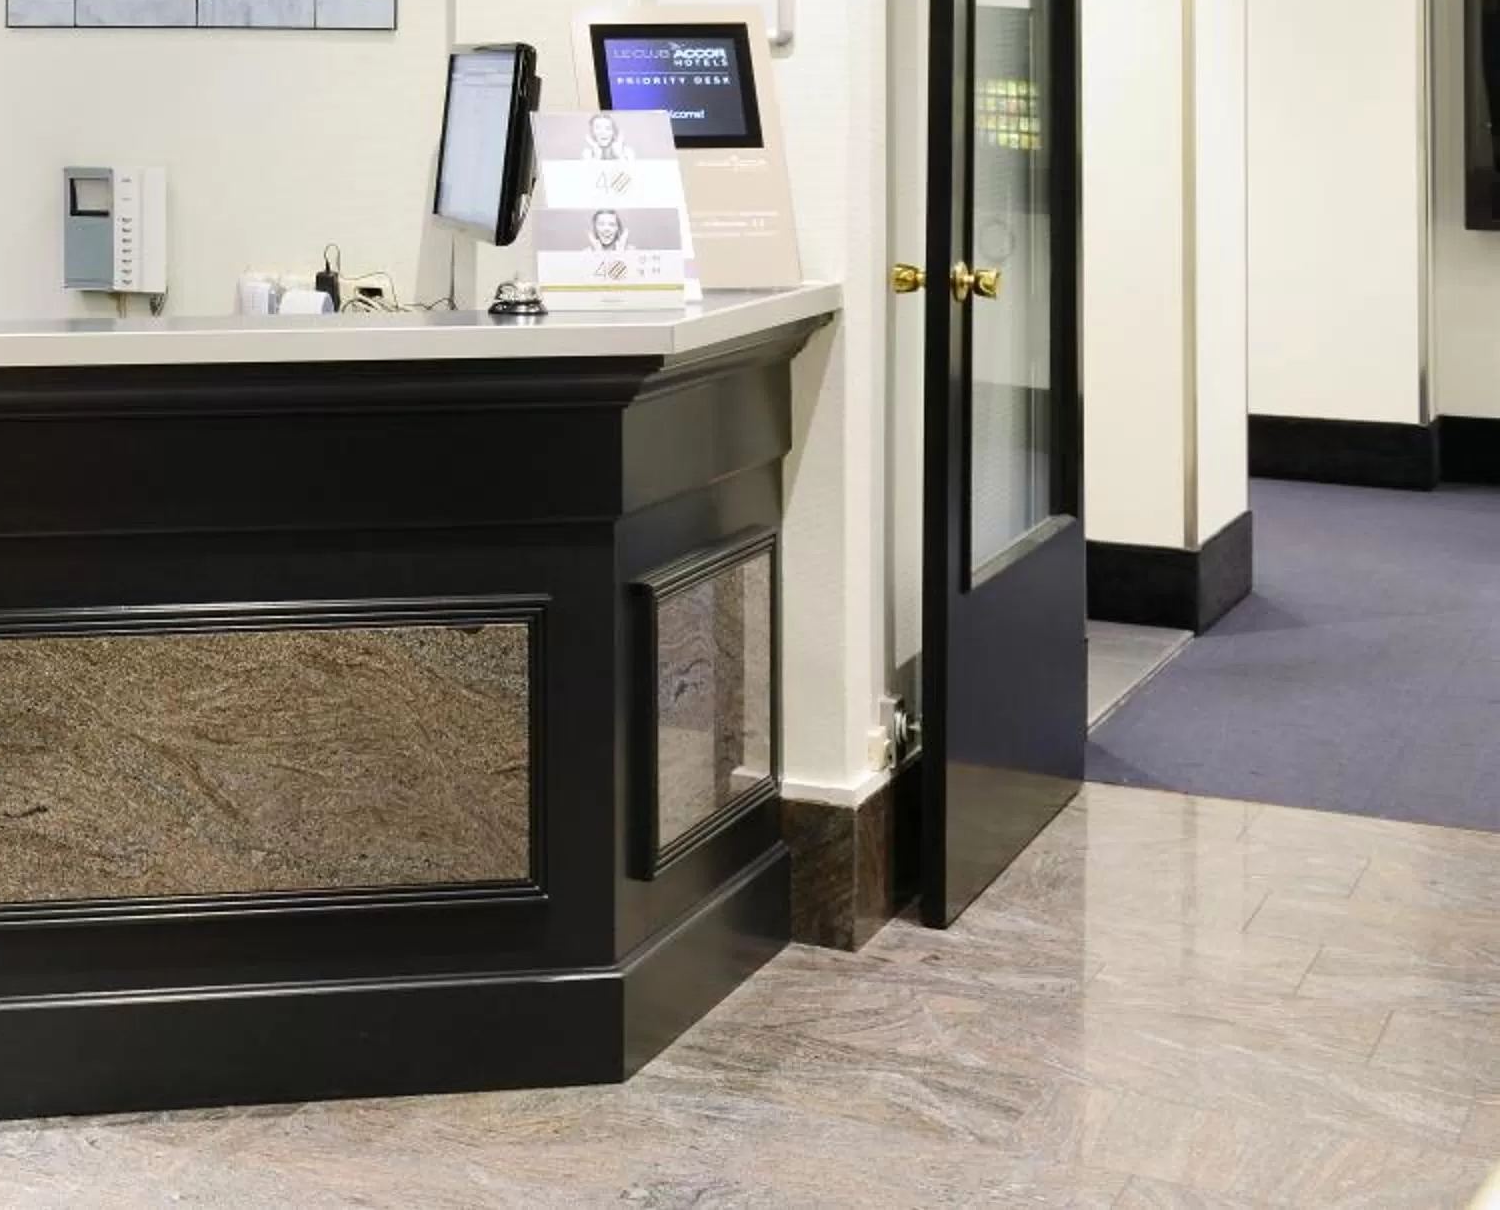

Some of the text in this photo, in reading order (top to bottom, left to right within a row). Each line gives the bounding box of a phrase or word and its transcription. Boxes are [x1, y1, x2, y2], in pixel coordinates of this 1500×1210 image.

[673, 59, 729, 67] HOTELS
[617, 76, 731, 85] PRIORITY DESK
[668, 109, 705, 119] lcome!
